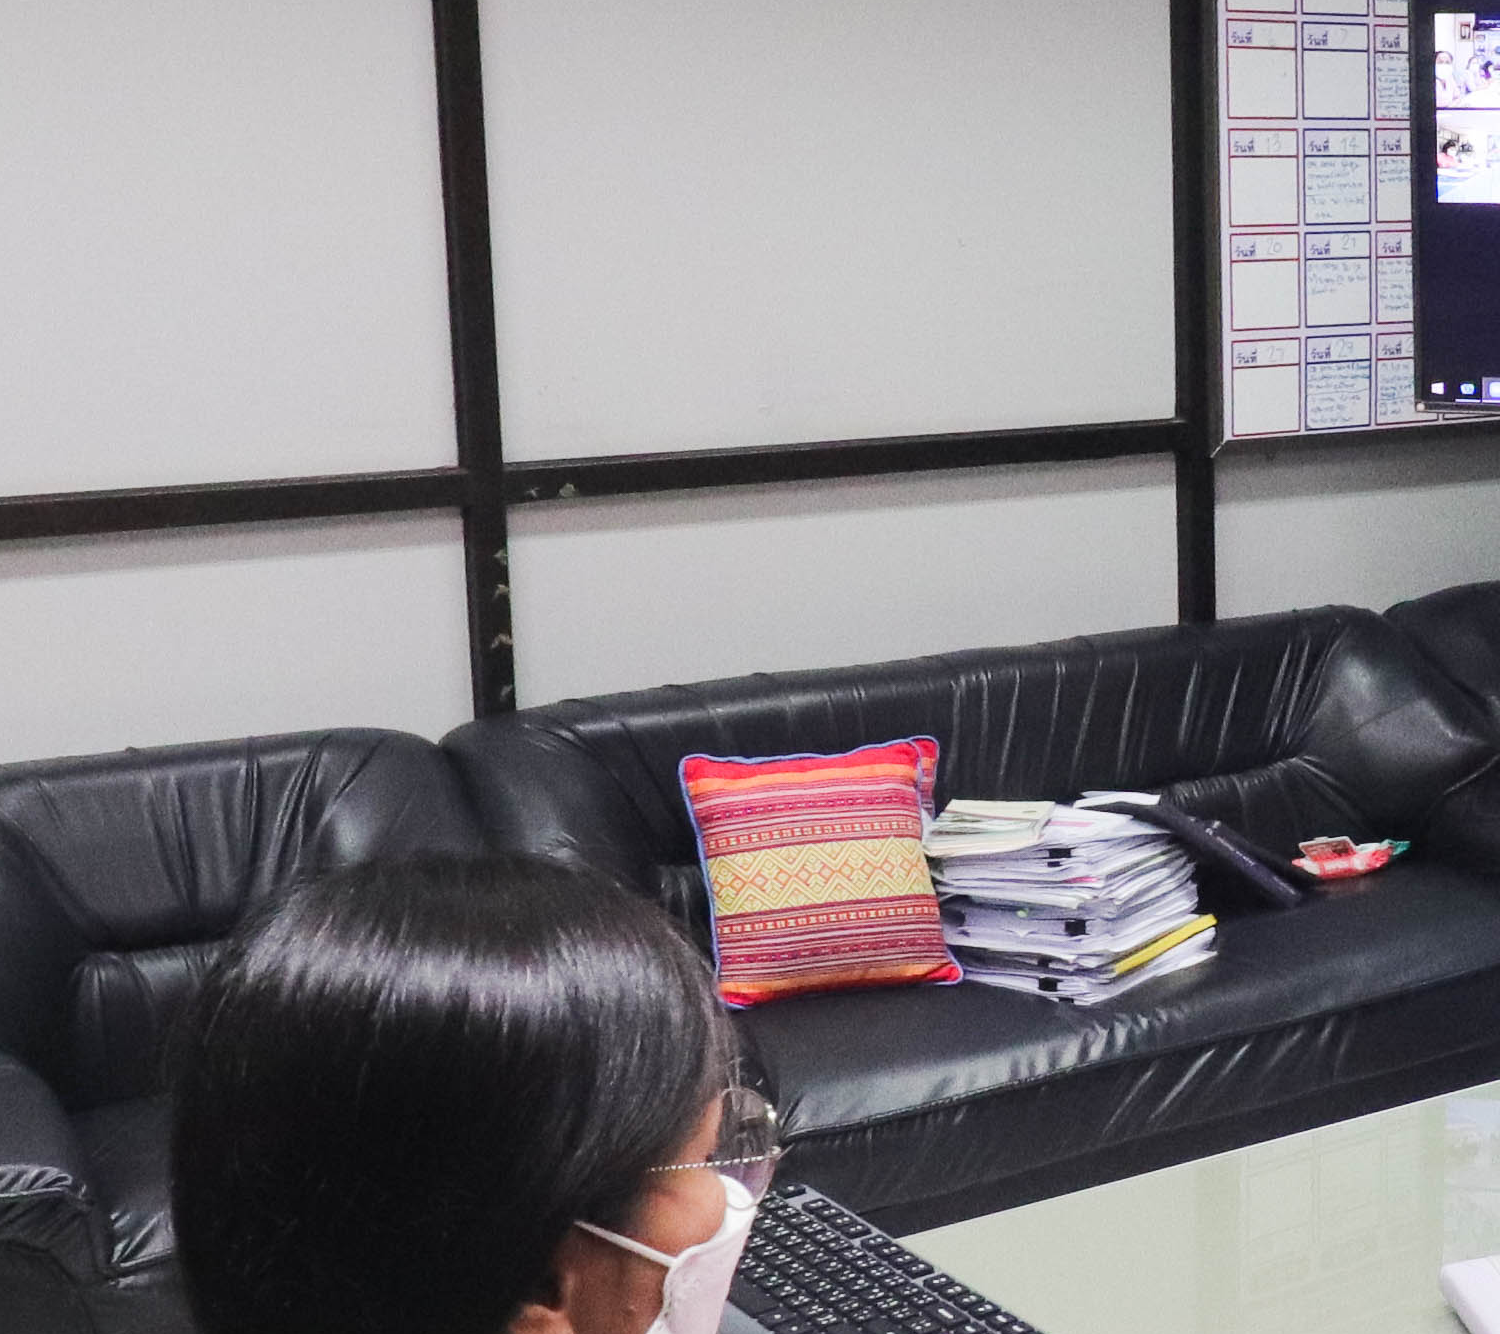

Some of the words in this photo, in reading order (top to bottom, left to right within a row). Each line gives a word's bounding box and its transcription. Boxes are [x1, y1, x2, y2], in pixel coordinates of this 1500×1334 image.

[1231, 28, 1253, 44] วันที่
[1307, 31, 1329, 46] วันที่
[1380, 33, 1401, 49] วันที่
[1233, 138, 1255, 153] วันที่
[1309, 138, 1330, 153] วันที่
[1382, 138, 1402, 152] วันที่
[1235, 242, 1256, 258] วันที่
[1310, 240, 1331, 255] วันที่
[1383, 241, 1403, 254] วันที่
[1310, 345, 1332, 360] วันที่
[1381, 342, 1403, 356] วันที่
[1236, 351, 1258, 364] วันที่
